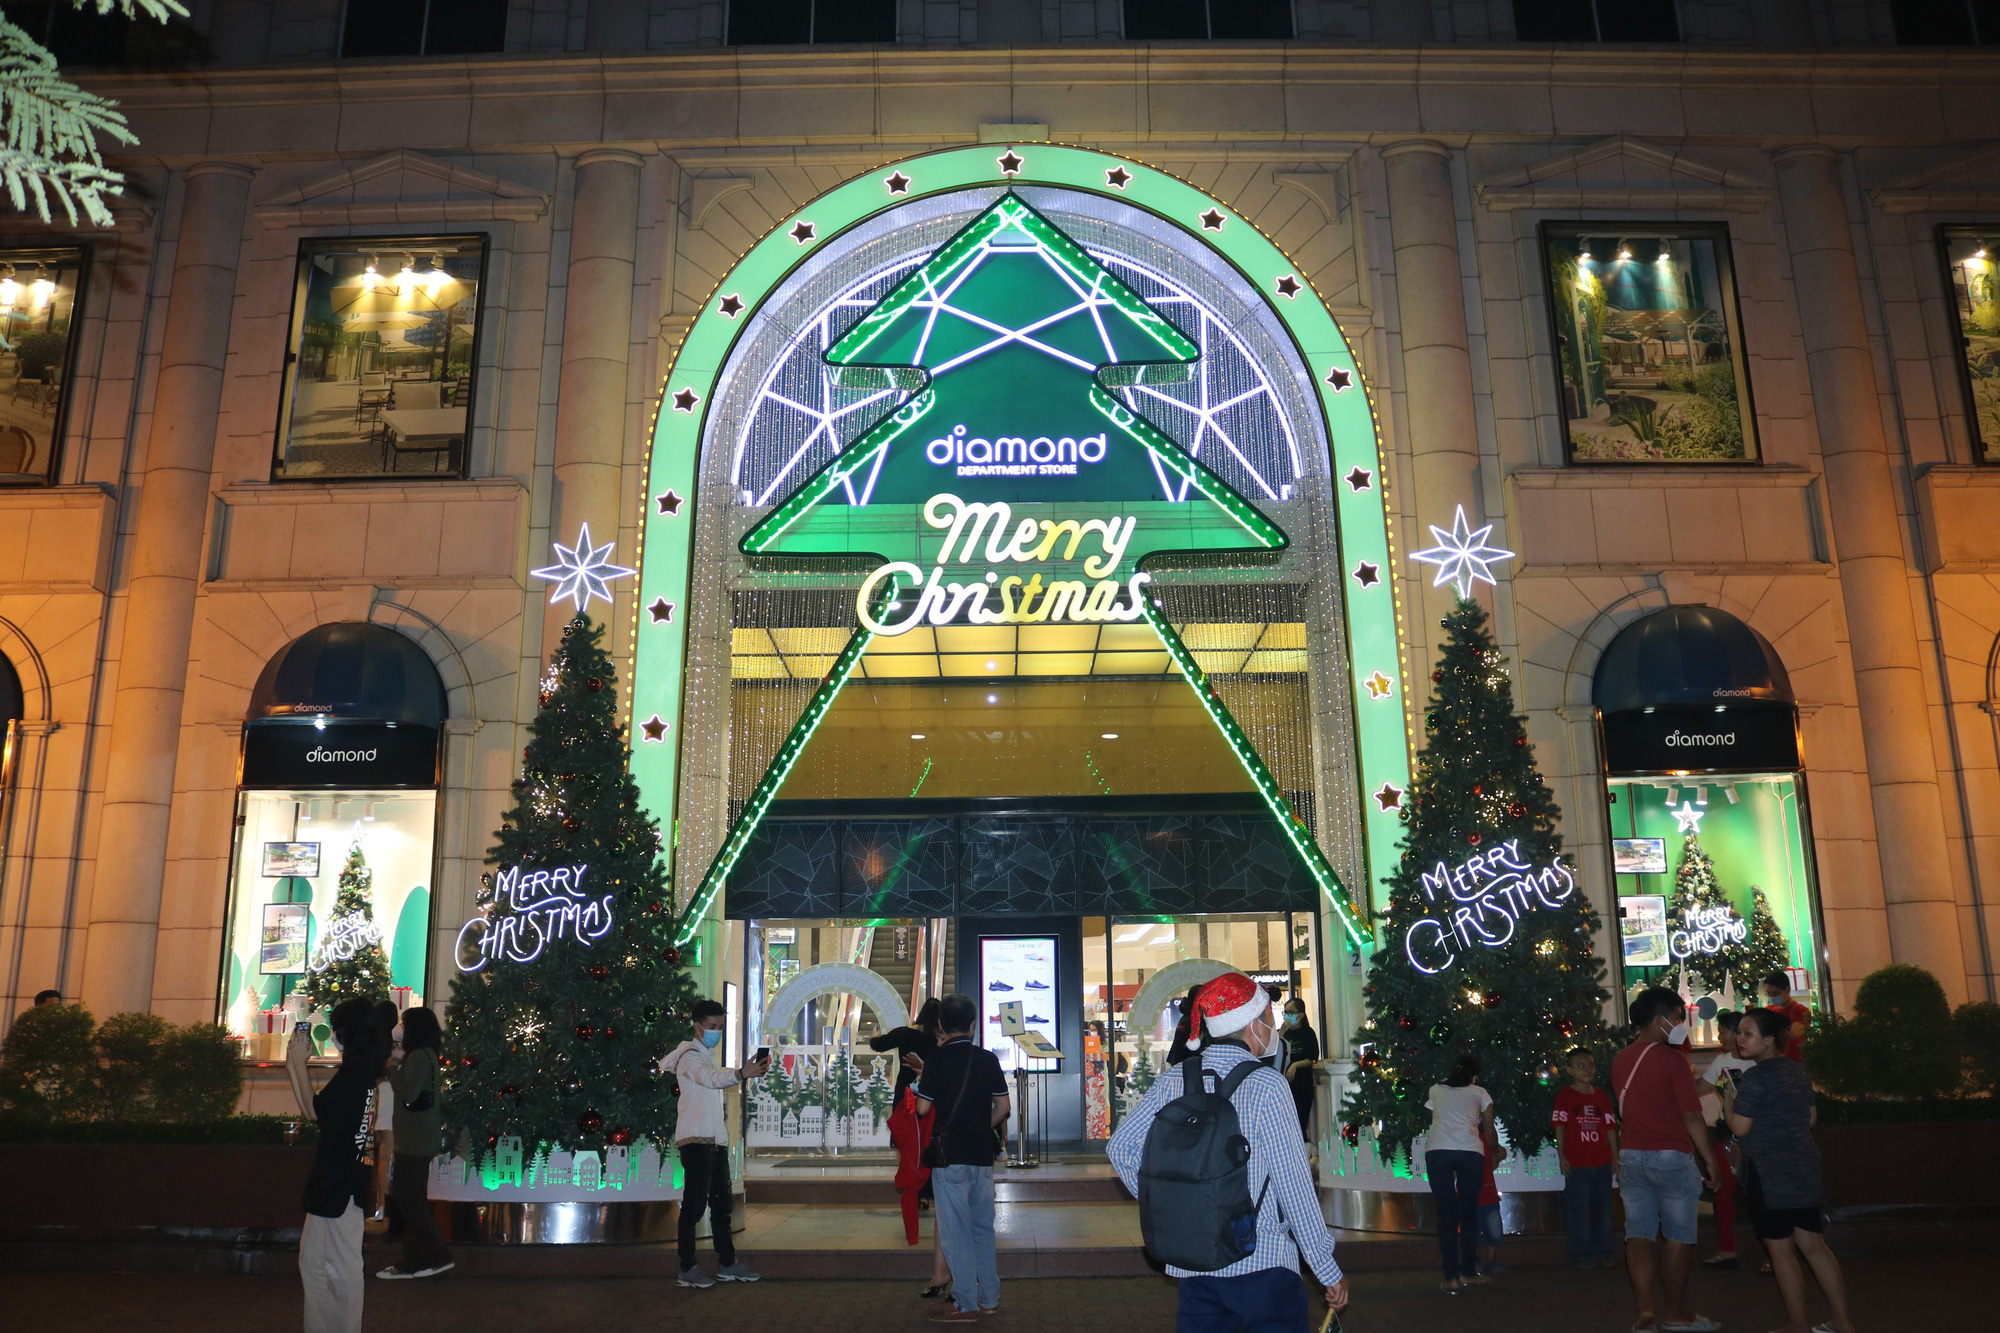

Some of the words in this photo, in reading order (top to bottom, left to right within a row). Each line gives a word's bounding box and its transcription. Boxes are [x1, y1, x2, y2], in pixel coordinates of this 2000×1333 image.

[926, 424, 1106, 465] diamond
[957, 465, 1037, 476] DEPARTMENT
[1039, 465, 1077, 475] STORE
[923, 492, 1136, 579] Merry
[856, 561, 1151, 636] Christmas
[294, 702, 332, 712] diamond
[1713, 687, 1750, 697] diamond
[306, 745, 377, 763] diamond
[1665, 729, 1735, 747] diamond
[494, 864, 587, 911] MERRY
[1421, 838, 1532, 901] MERRY
[455, 895, 613, 972] CHRISTMAS
[1406, 856, 1573, 974] CHRISTMAS
[1685, 903, 1733, 930] MERRY
[1670, 918, 1747, 958] CHRISTMAS
[778, 973, 841, 1017] CHRISTMAS
[844, 974, 877, 995] WITH
[876, 990, 896, 1017] YOU
[1143, 969, 1204, 1014] CHRISTMAS
[1552, 1110, 1569, 1123] ES
[1580, 1130, 1599, 1142] NO
